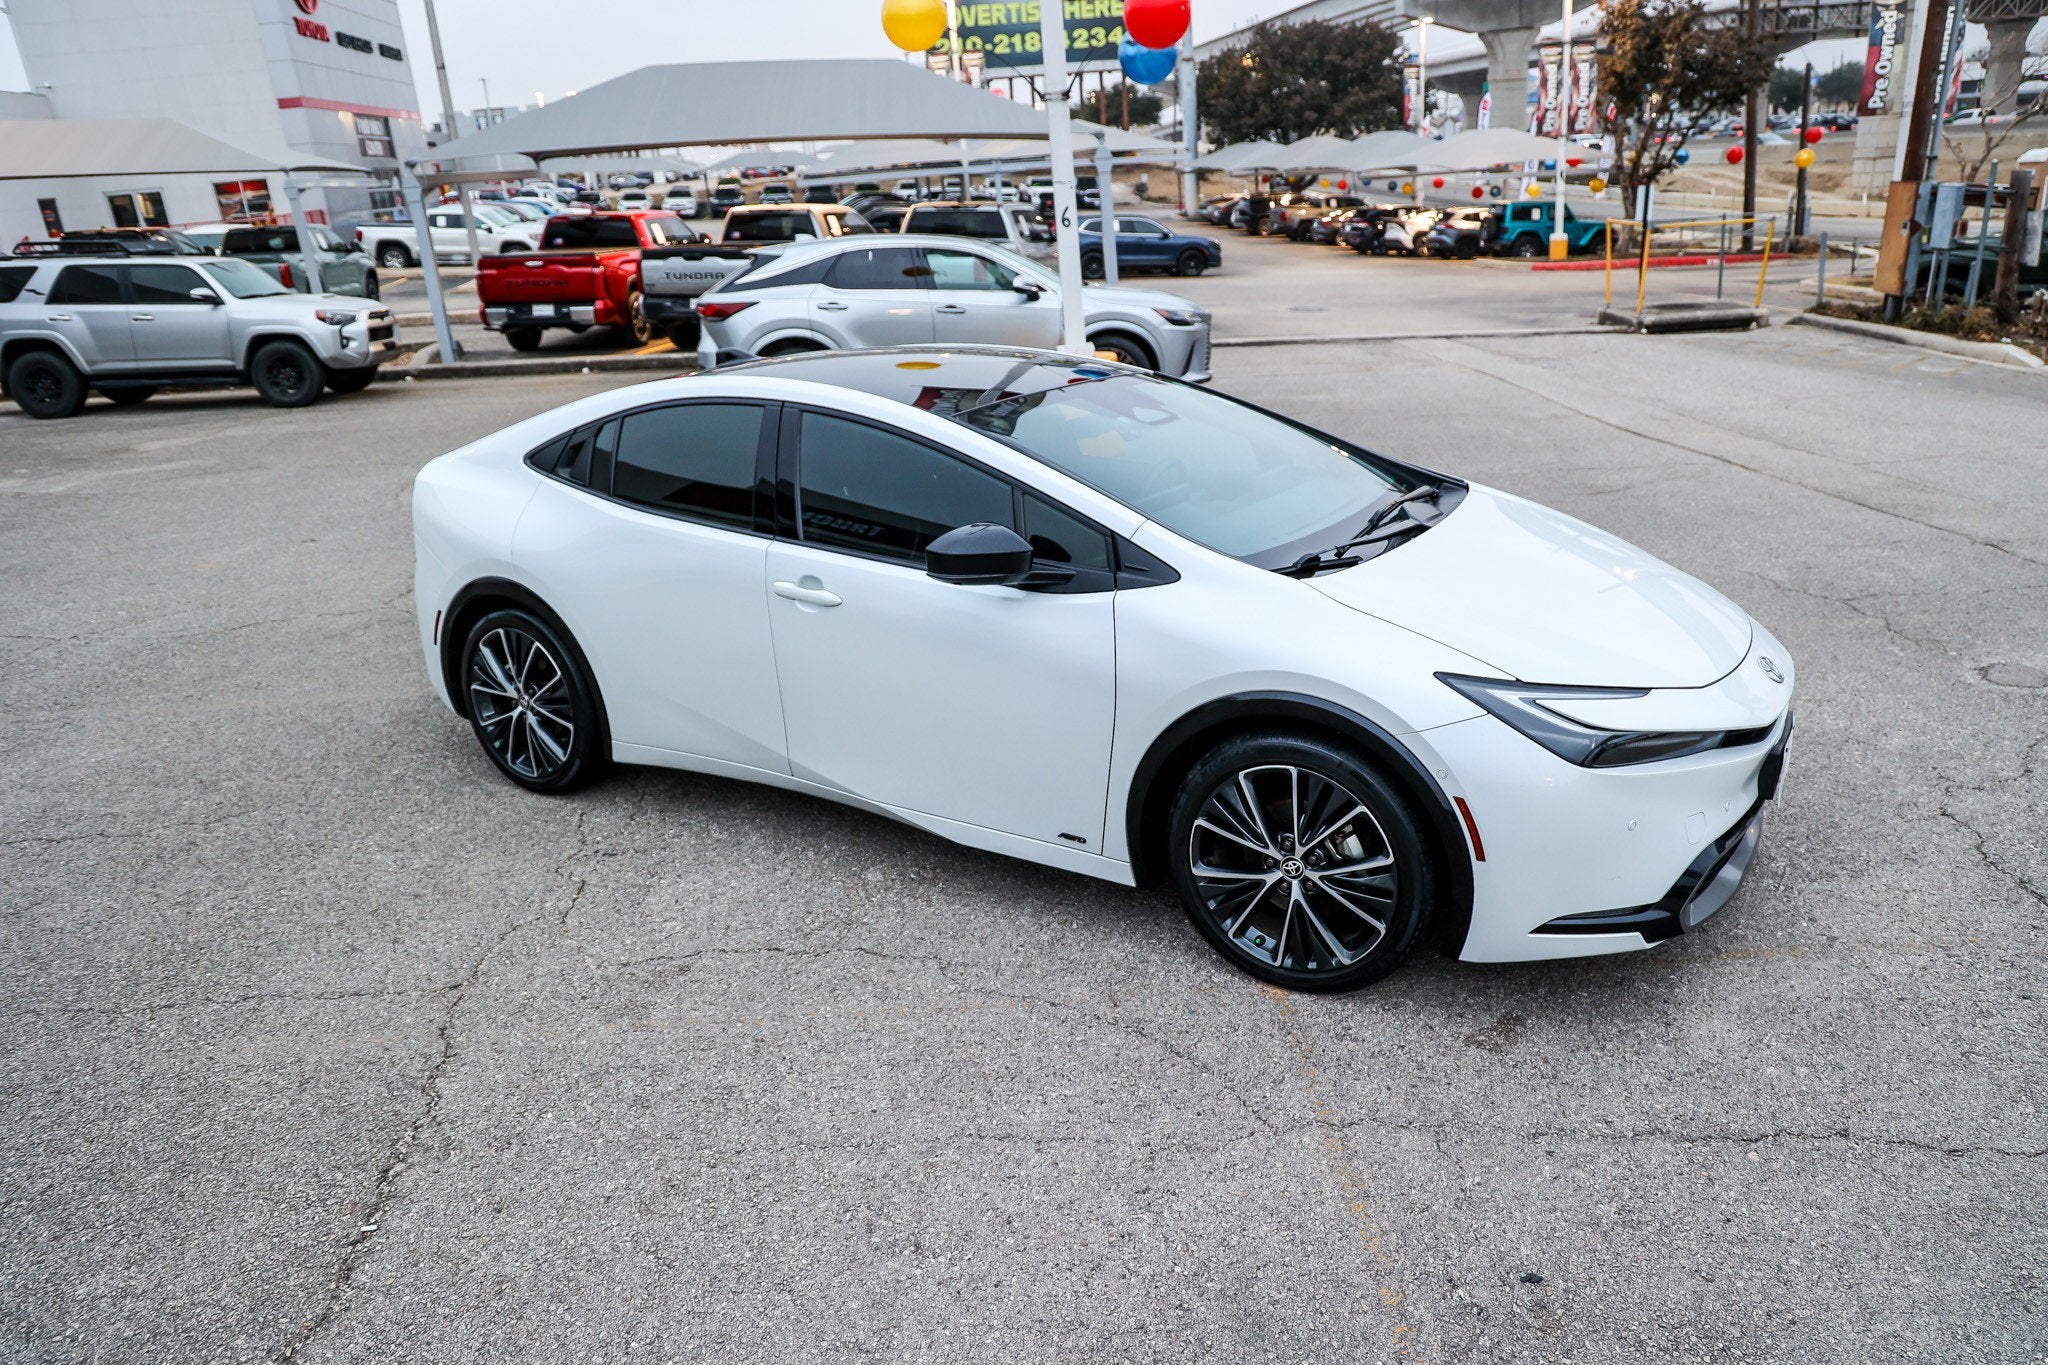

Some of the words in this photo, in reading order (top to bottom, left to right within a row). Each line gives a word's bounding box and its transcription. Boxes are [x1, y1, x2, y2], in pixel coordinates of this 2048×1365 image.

[1063, 0, 1125, 20] HERE
[1874, 10, 1899, 75] Owned
[1867, 77, 1889, 109] Pre
[1061, 206, 1071, 228] 6
[663, 271, 726, 280] TUNDRA
